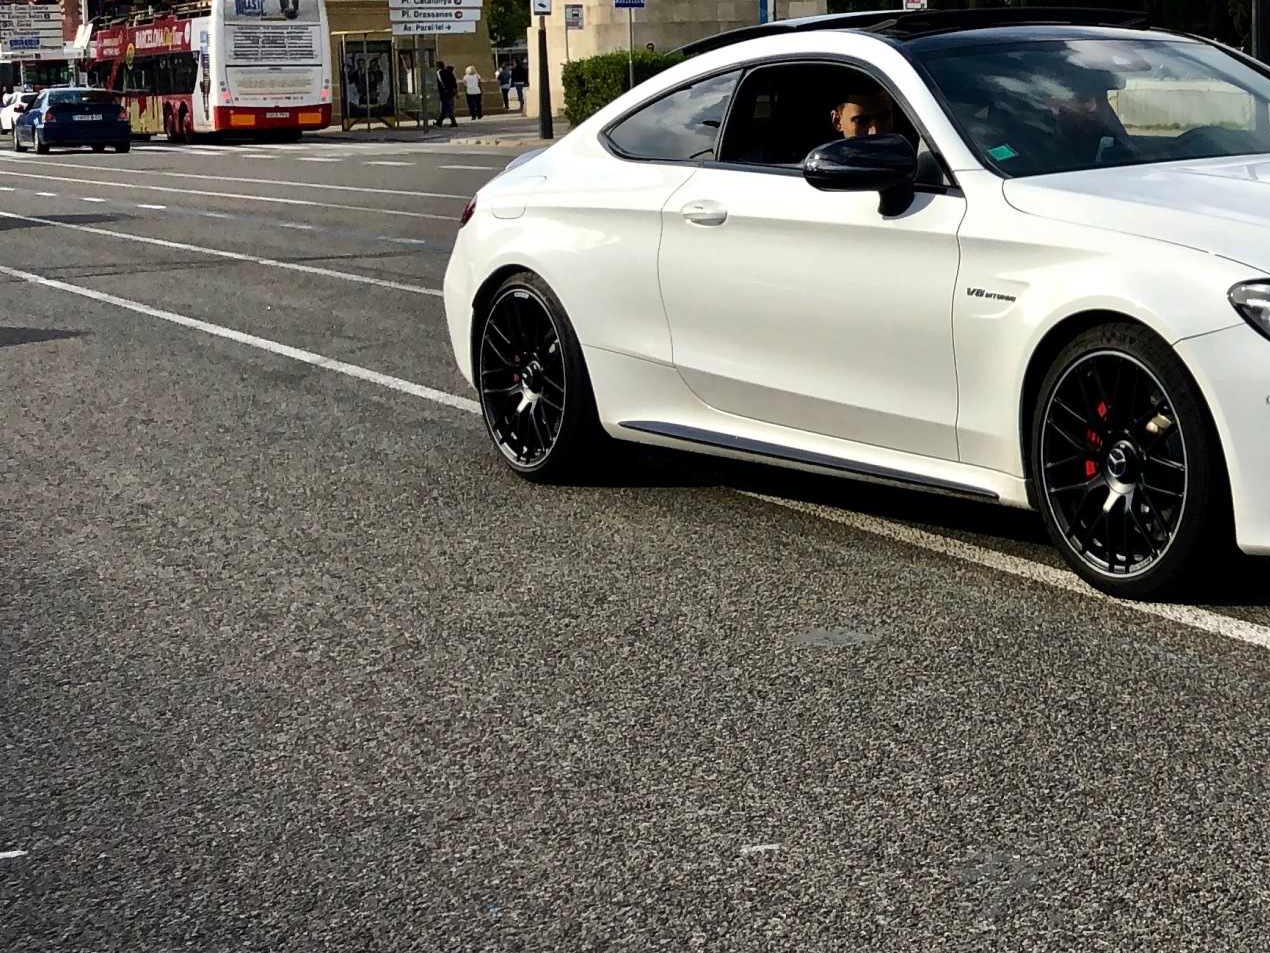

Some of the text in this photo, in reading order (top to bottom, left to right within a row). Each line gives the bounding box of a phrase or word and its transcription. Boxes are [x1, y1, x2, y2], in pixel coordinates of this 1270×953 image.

[401, 10, 453, 18] Pl. Drassanes
[966, 287, 985, 297] V8
